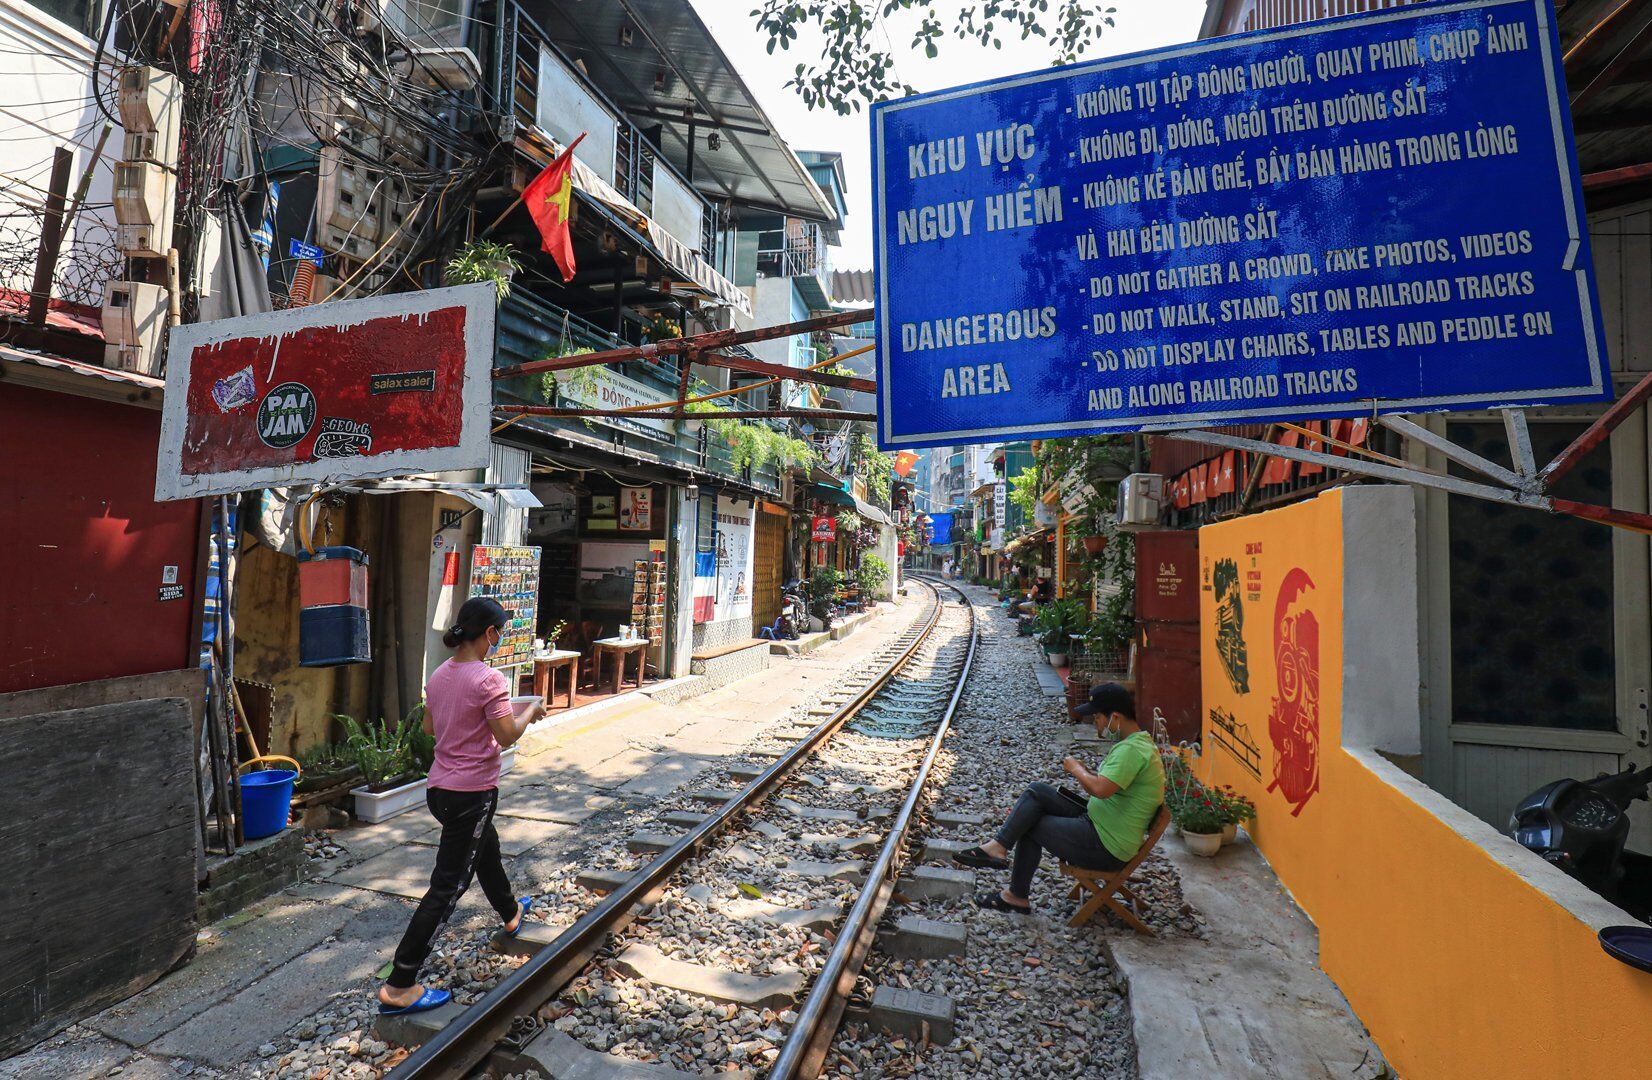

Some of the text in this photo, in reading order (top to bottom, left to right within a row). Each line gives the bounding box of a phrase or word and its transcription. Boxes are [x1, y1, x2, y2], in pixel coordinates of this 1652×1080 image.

[1076, 85, 1132, 119] KHÔNG
[1136, 81, 1156, 113] TỤ
[1161, 72, 1192, 109] TẬP
[1198, 65, 1246, 99] ĐÔNG
[1250, 50, 1312, 90] NGƯỜI,
[1316, 46, 1362, 82] QUAY
[1369, 38, 1425, 72] PHIM,
[1430, 29, 1480, 65] CHỤP
[1488, 14, 1528, 54] ẢNH
[1080, 129, 1136, 164] KHÔNG
[1167, 114, 1220, 150] ĐỨNG,
[1224, 102, 1268, 141] NGỒI
[1271, 98, 1318, 134] TRÊN
[1323, 89, 1388, 127] ĐƯỜNG
[1392, 78, 1426, 117] SẮT
[909, 123, 1035, 179] KHU VỰC
[1084, 175, 1140, 209] KHÔNG
[1144, 167, 1166, 201] KÊ
[1171, 163, 1208, 197] BÀN
[1212, 151, 1252, 191] GHẾ,
[1296, 145, 1336, 180] BÁN
[1339, 139, 1392, 174] HÀNG
[1396, 132, 1461, 167] TRONG
[1465, 122, 1518, 159] LÒNG
[898, 174, 1063, 245] NGUY HIỂM
[1076, 203, 1277, 261] VÀ HAI BÊN ĐƯỜNG SẮT
[1090, 276, 1112, 298] DO
[1118, 271, 1150, 295] NOT
[1156, 263, 1222, 291] GATHER
[1228, 261, 1240, 283] A
[1245, 253, 1318, 281] CROWD,
[1326, 246, 1370, 273] TAKE
[1374, 239, 1456, 268] PHOTOS,
[1460, 230, 1532, 259] VIDEOS
[902, 307, 1056, 352] DANGEROUS
[1094, 312, 1116, 335] DO
[1121, 308, 1154, 332] NOT
[1159, 303, 1215, 328] WALK,
[1220, 296, 1286, 322] STAND,
[1290, 291, 1318, 315] SIT
[1324, 288, 1351, 312] ON
[1356, 279, 1450, 309] RAILROAD
[1455, 271, 1534, 300] TRACKS
[1092, 350, 1119, 372] DO
[1122, 346, 1156, 370] NOT
[1162, 338, 1235, 366] DISPLAY
[1242, 332, 1316, 359] CHAIRS,
[1319, 325, 1390, 353] TABLES
[1397, 321, 1436, 347] AND
[1442, 314, 1518, 343] PEDDLE
[1523, 312, 1552, 337] ON
[267, 392, 309, 411] PAI
[942, 363, 1011, 398] AREA
[1088, 368, 1358, 411] AND ALONG RAILROAD TRACKS
[262, 414, 305, 437] JAM
